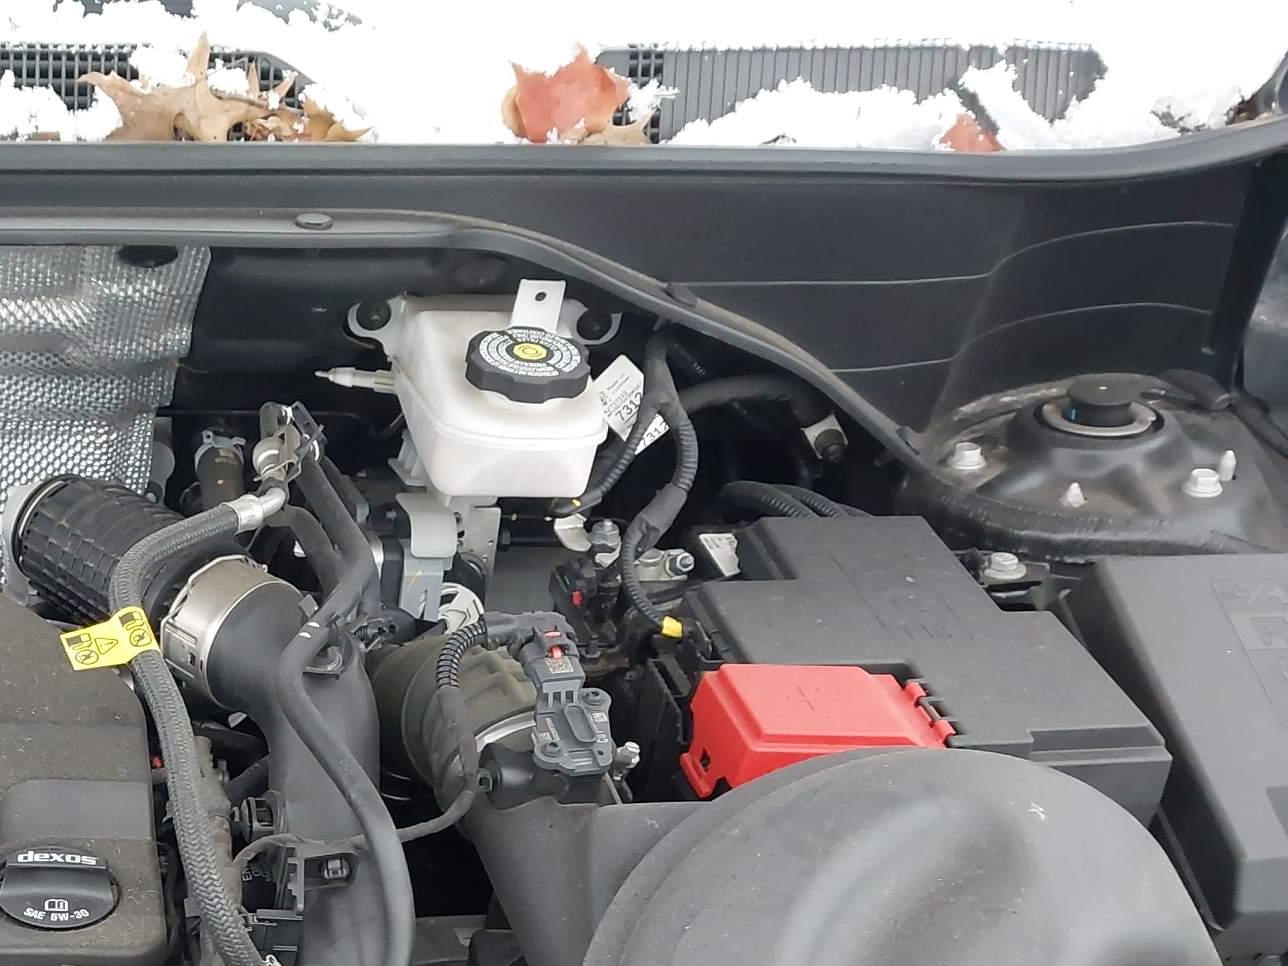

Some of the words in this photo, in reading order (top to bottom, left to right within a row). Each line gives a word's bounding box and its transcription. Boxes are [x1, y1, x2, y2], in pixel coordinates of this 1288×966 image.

[17, 850, 99, 866] dexos
[23, 907, 46, 920] SAE
[50, 908, 90, 921] 5W-30
